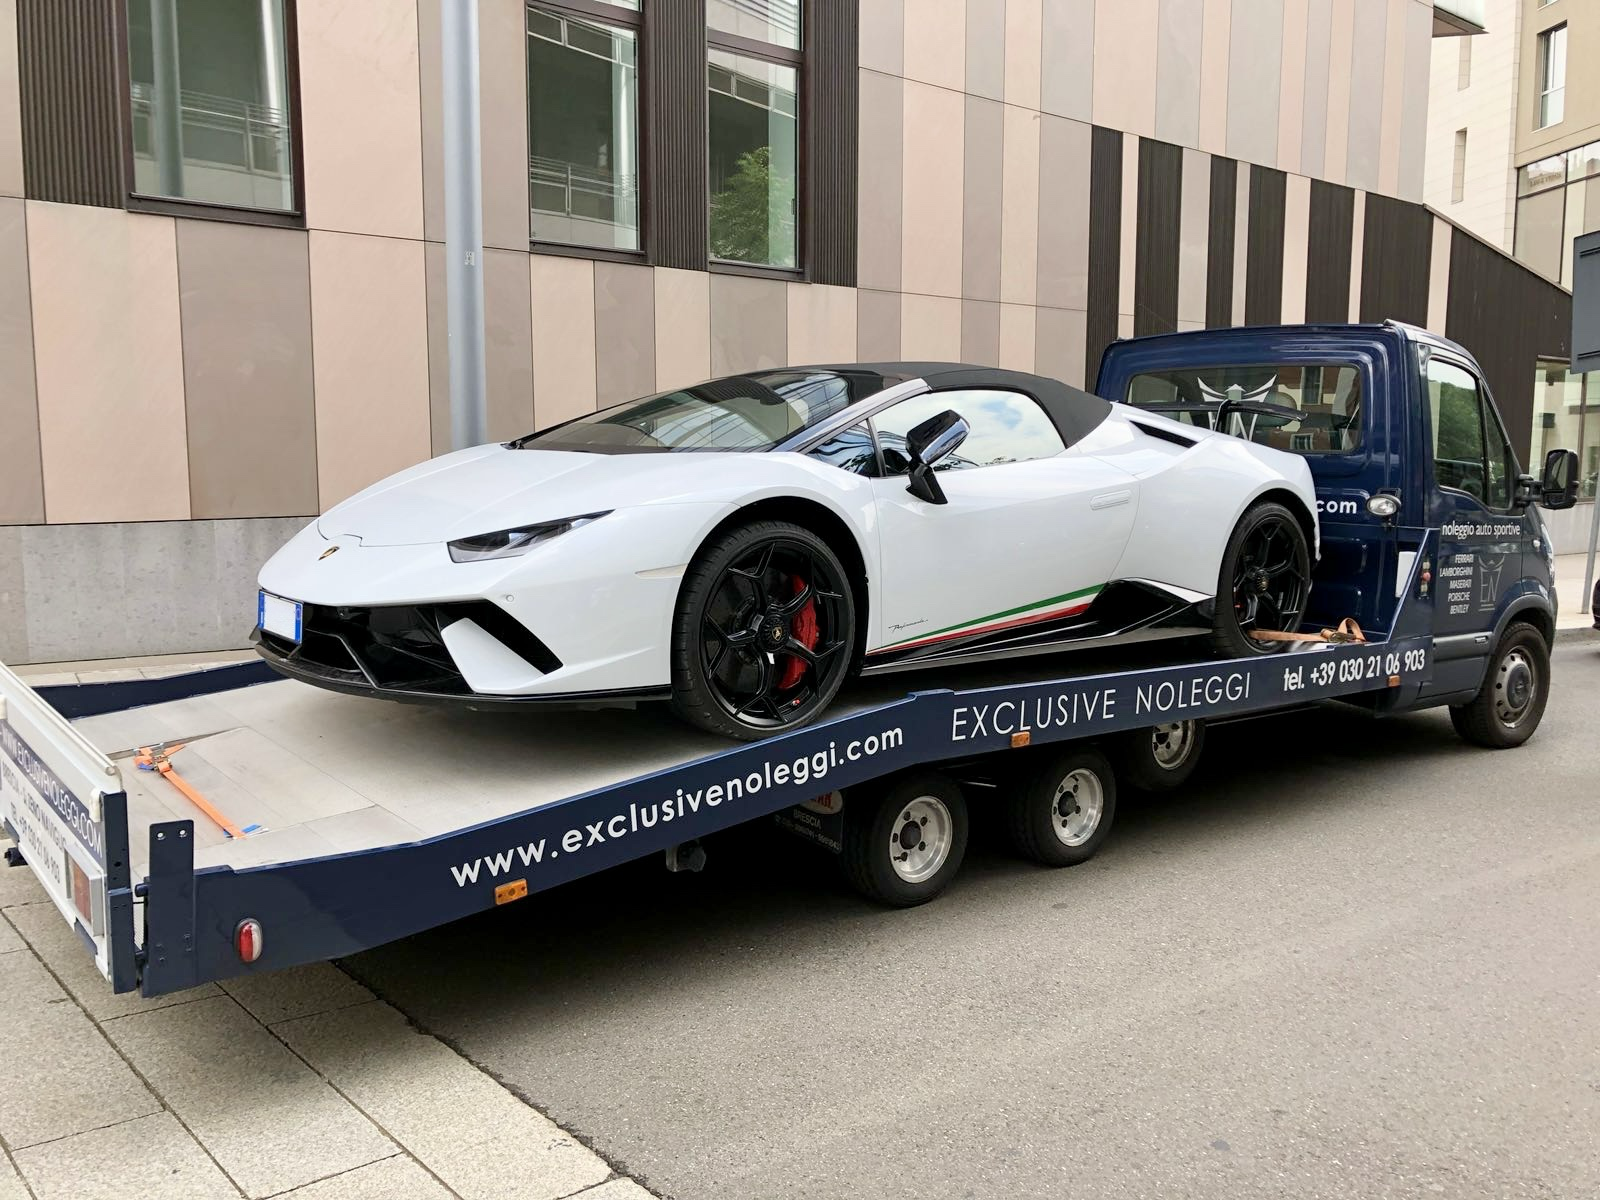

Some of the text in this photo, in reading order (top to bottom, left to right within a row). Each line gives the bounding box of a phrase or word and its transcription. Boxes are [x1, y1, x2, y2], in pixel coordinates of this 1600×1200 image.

[1442, 520, 1520, 539] noleggio auto sportive
[1455, 554, 1474, 564] FERRARI
[1440, 566, 1473, 577] LAMBORGHINI
[1449, 579, 1472, 589] MASERATI
[1447, 591, 1471, 602] PORSCHE
[1449, 604, 1470, 614] BENTLEY
[1283, 648, 1426, 691] tel. +39 030 21 06 903
[952, 672, 1251, 741] EXCLUSIVE NOLEGGI
[450, 725, 904, 888] www.exclusivenoleggi.com
